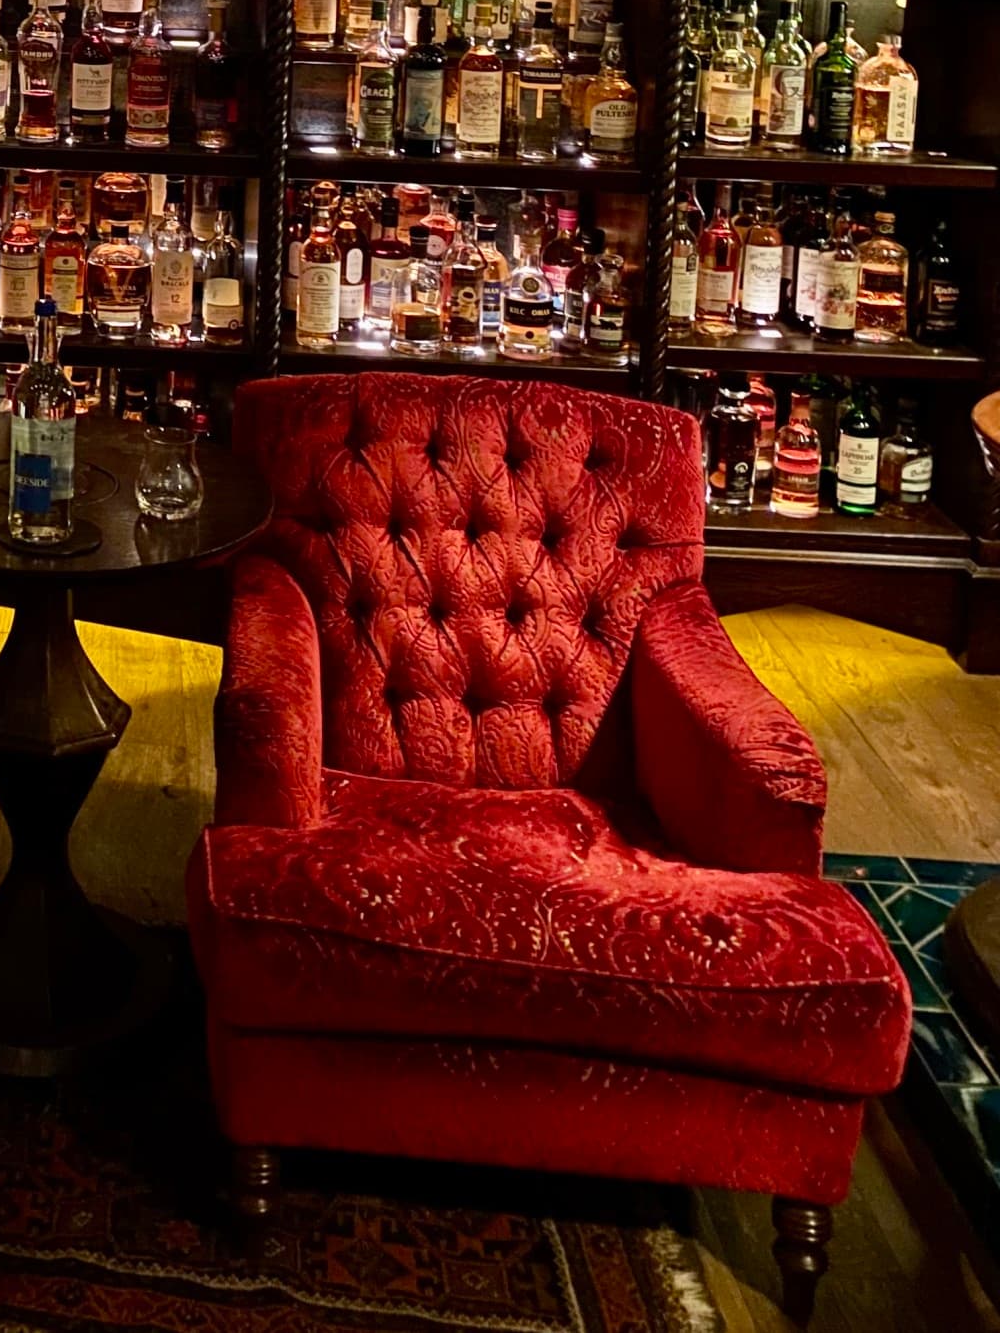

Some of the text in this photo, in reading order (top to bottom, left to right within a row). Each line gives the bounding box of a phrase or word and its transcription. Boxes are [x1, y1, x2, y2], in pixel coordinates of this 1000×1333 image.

[20, 49, 54, 58] TAMDHU
[359, 85, 390, 95] GRACE
[607, 103, 627, 111] OLD
[895, 84, 908, 138] RAASAY
[595, 110, 634, 118] PULTENE
[170, 293, 180, 303] 12
